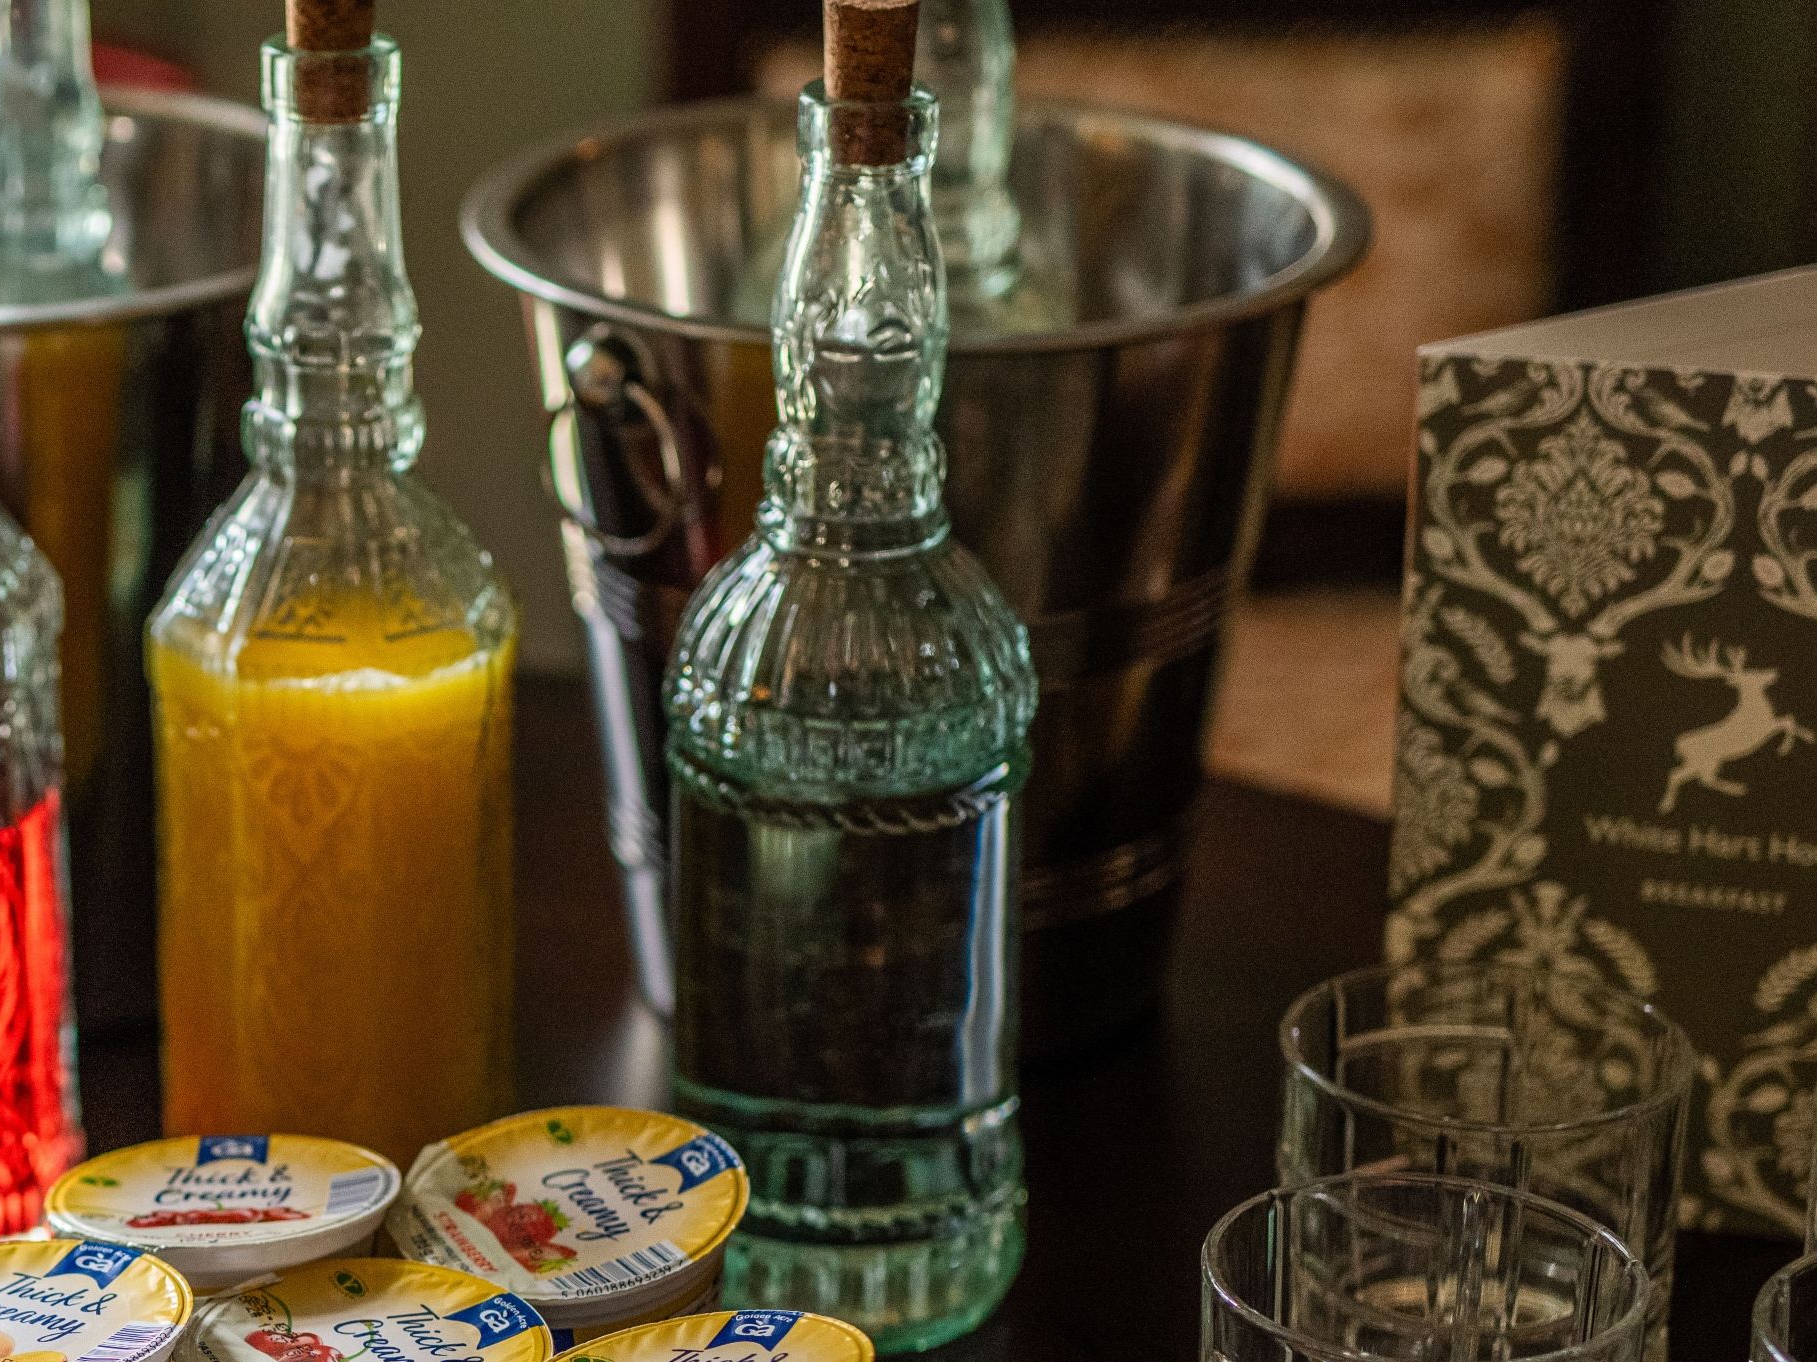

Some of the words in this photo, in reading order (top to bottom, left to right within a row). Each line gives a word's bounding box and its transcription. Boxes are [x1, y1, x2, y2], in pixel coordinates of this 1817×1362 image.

[1767, 831, 1817, 867] Ho
[164, 1164, 258, 1187] Thick
[267, 1162, 293, 1183] &
[593, 1147, 669, 1207] Thick
[639, 1200, 684, 1225] &
[153, 1184, 292, 1208] Creamy
[541, 1167, 632, 1243] Creamy
[79, 1244, 114, 1255] Golden
[12, 1272, 89, 1307] Thick
[80, 1293, 118, 1316] &
[386, 1303, 467, 1357] Thick
[493, 1297, 519, 1317] Golden
[514, 1313, 528, 1329] Acre
[735, 1314, 773, 1323] Golden
